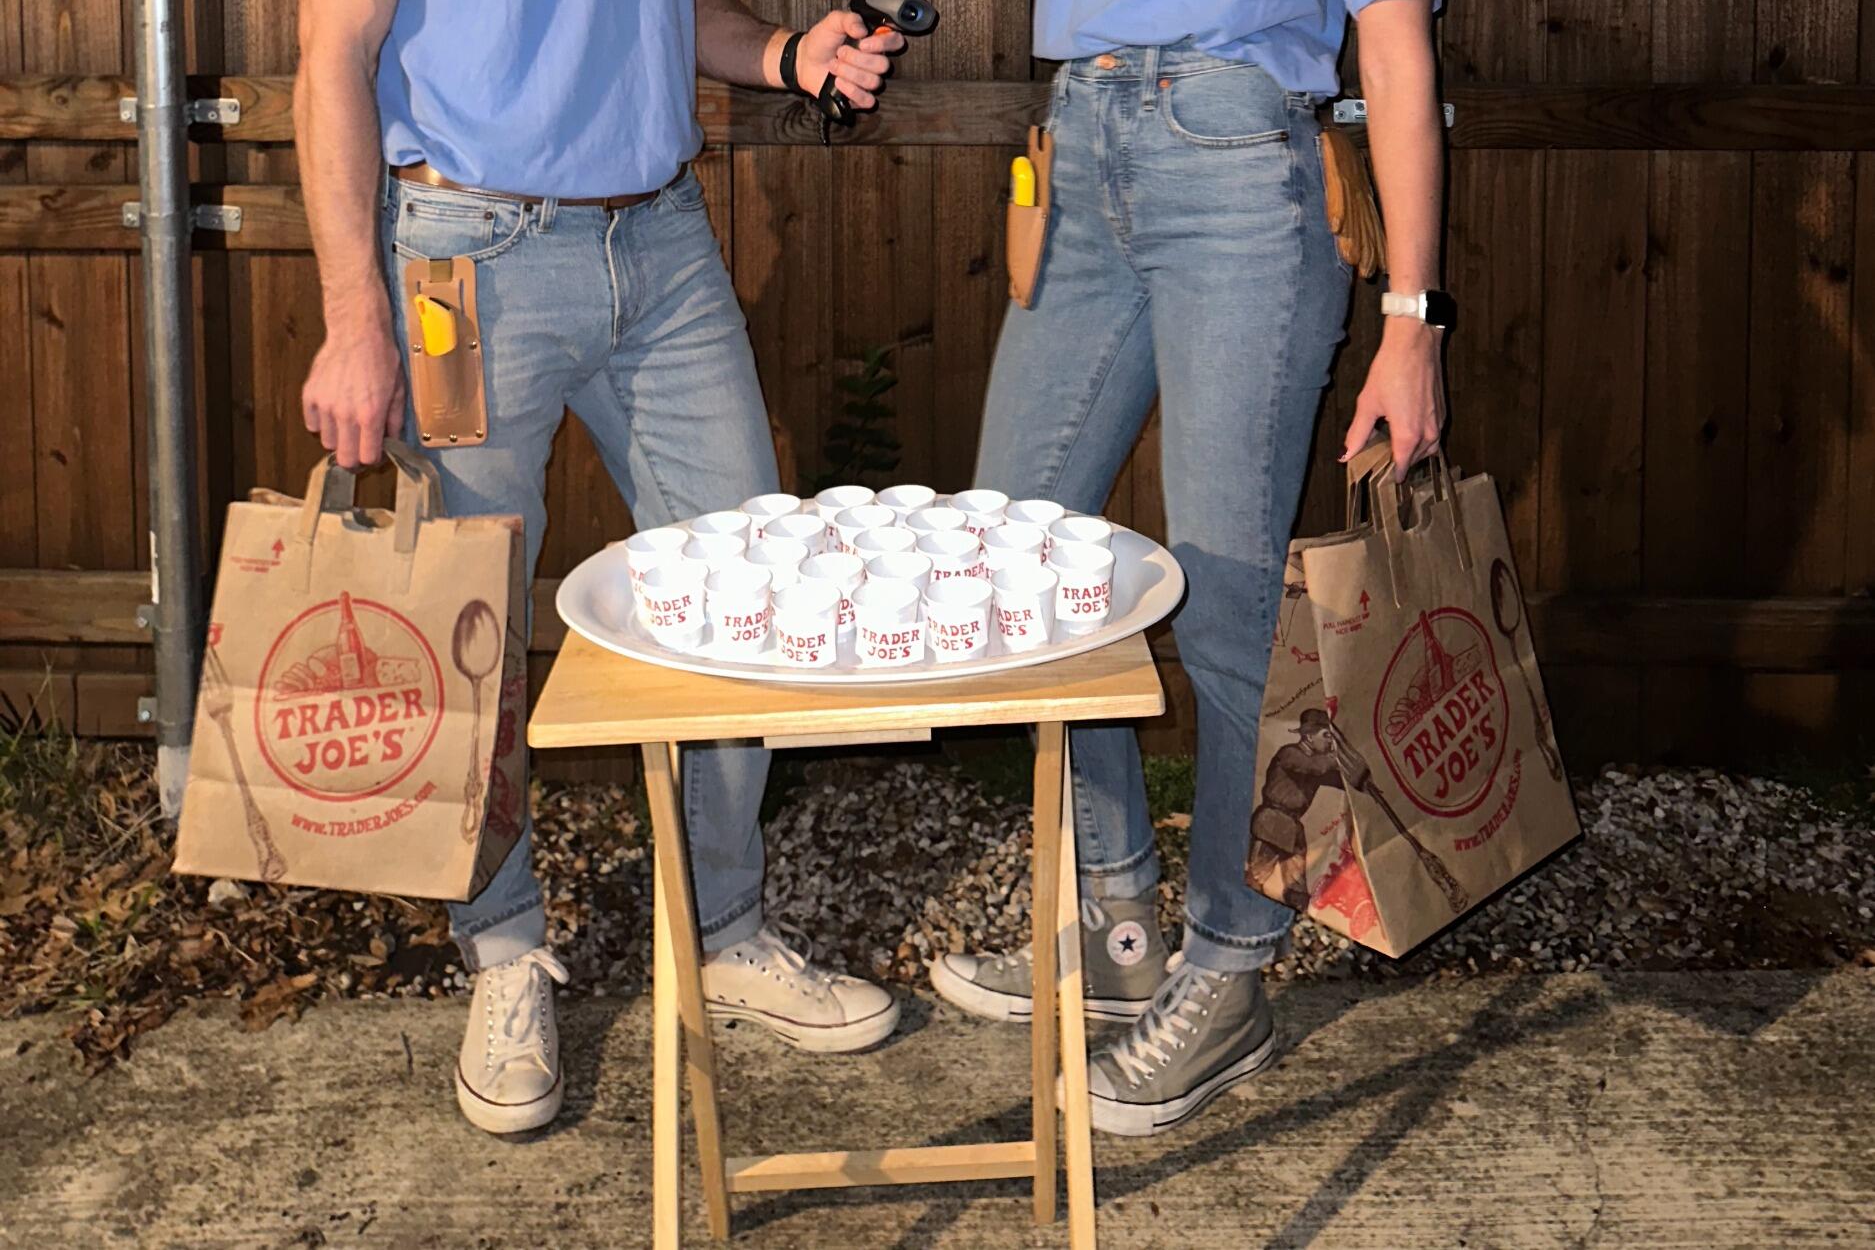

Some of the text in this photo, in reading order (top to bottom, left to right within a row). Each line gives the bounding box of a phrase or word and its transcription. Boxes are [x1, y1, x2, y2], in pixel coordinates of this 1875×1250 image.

[1062, 581, 1109, 600] TRADE
[862, 627, 920, 646] TRADER
[927, 616, 981, 637] TRADER
[867, 645, 912, 660] JOE'S
[934, 636, 975, 651] JOE'S
[273, 688, 427, 740] TRADER
[1403, 670, 1495, 779] TRADER
[294, 728, 405, 775] JOE'S
[1434, 711, 1496, 799] JOE'S
